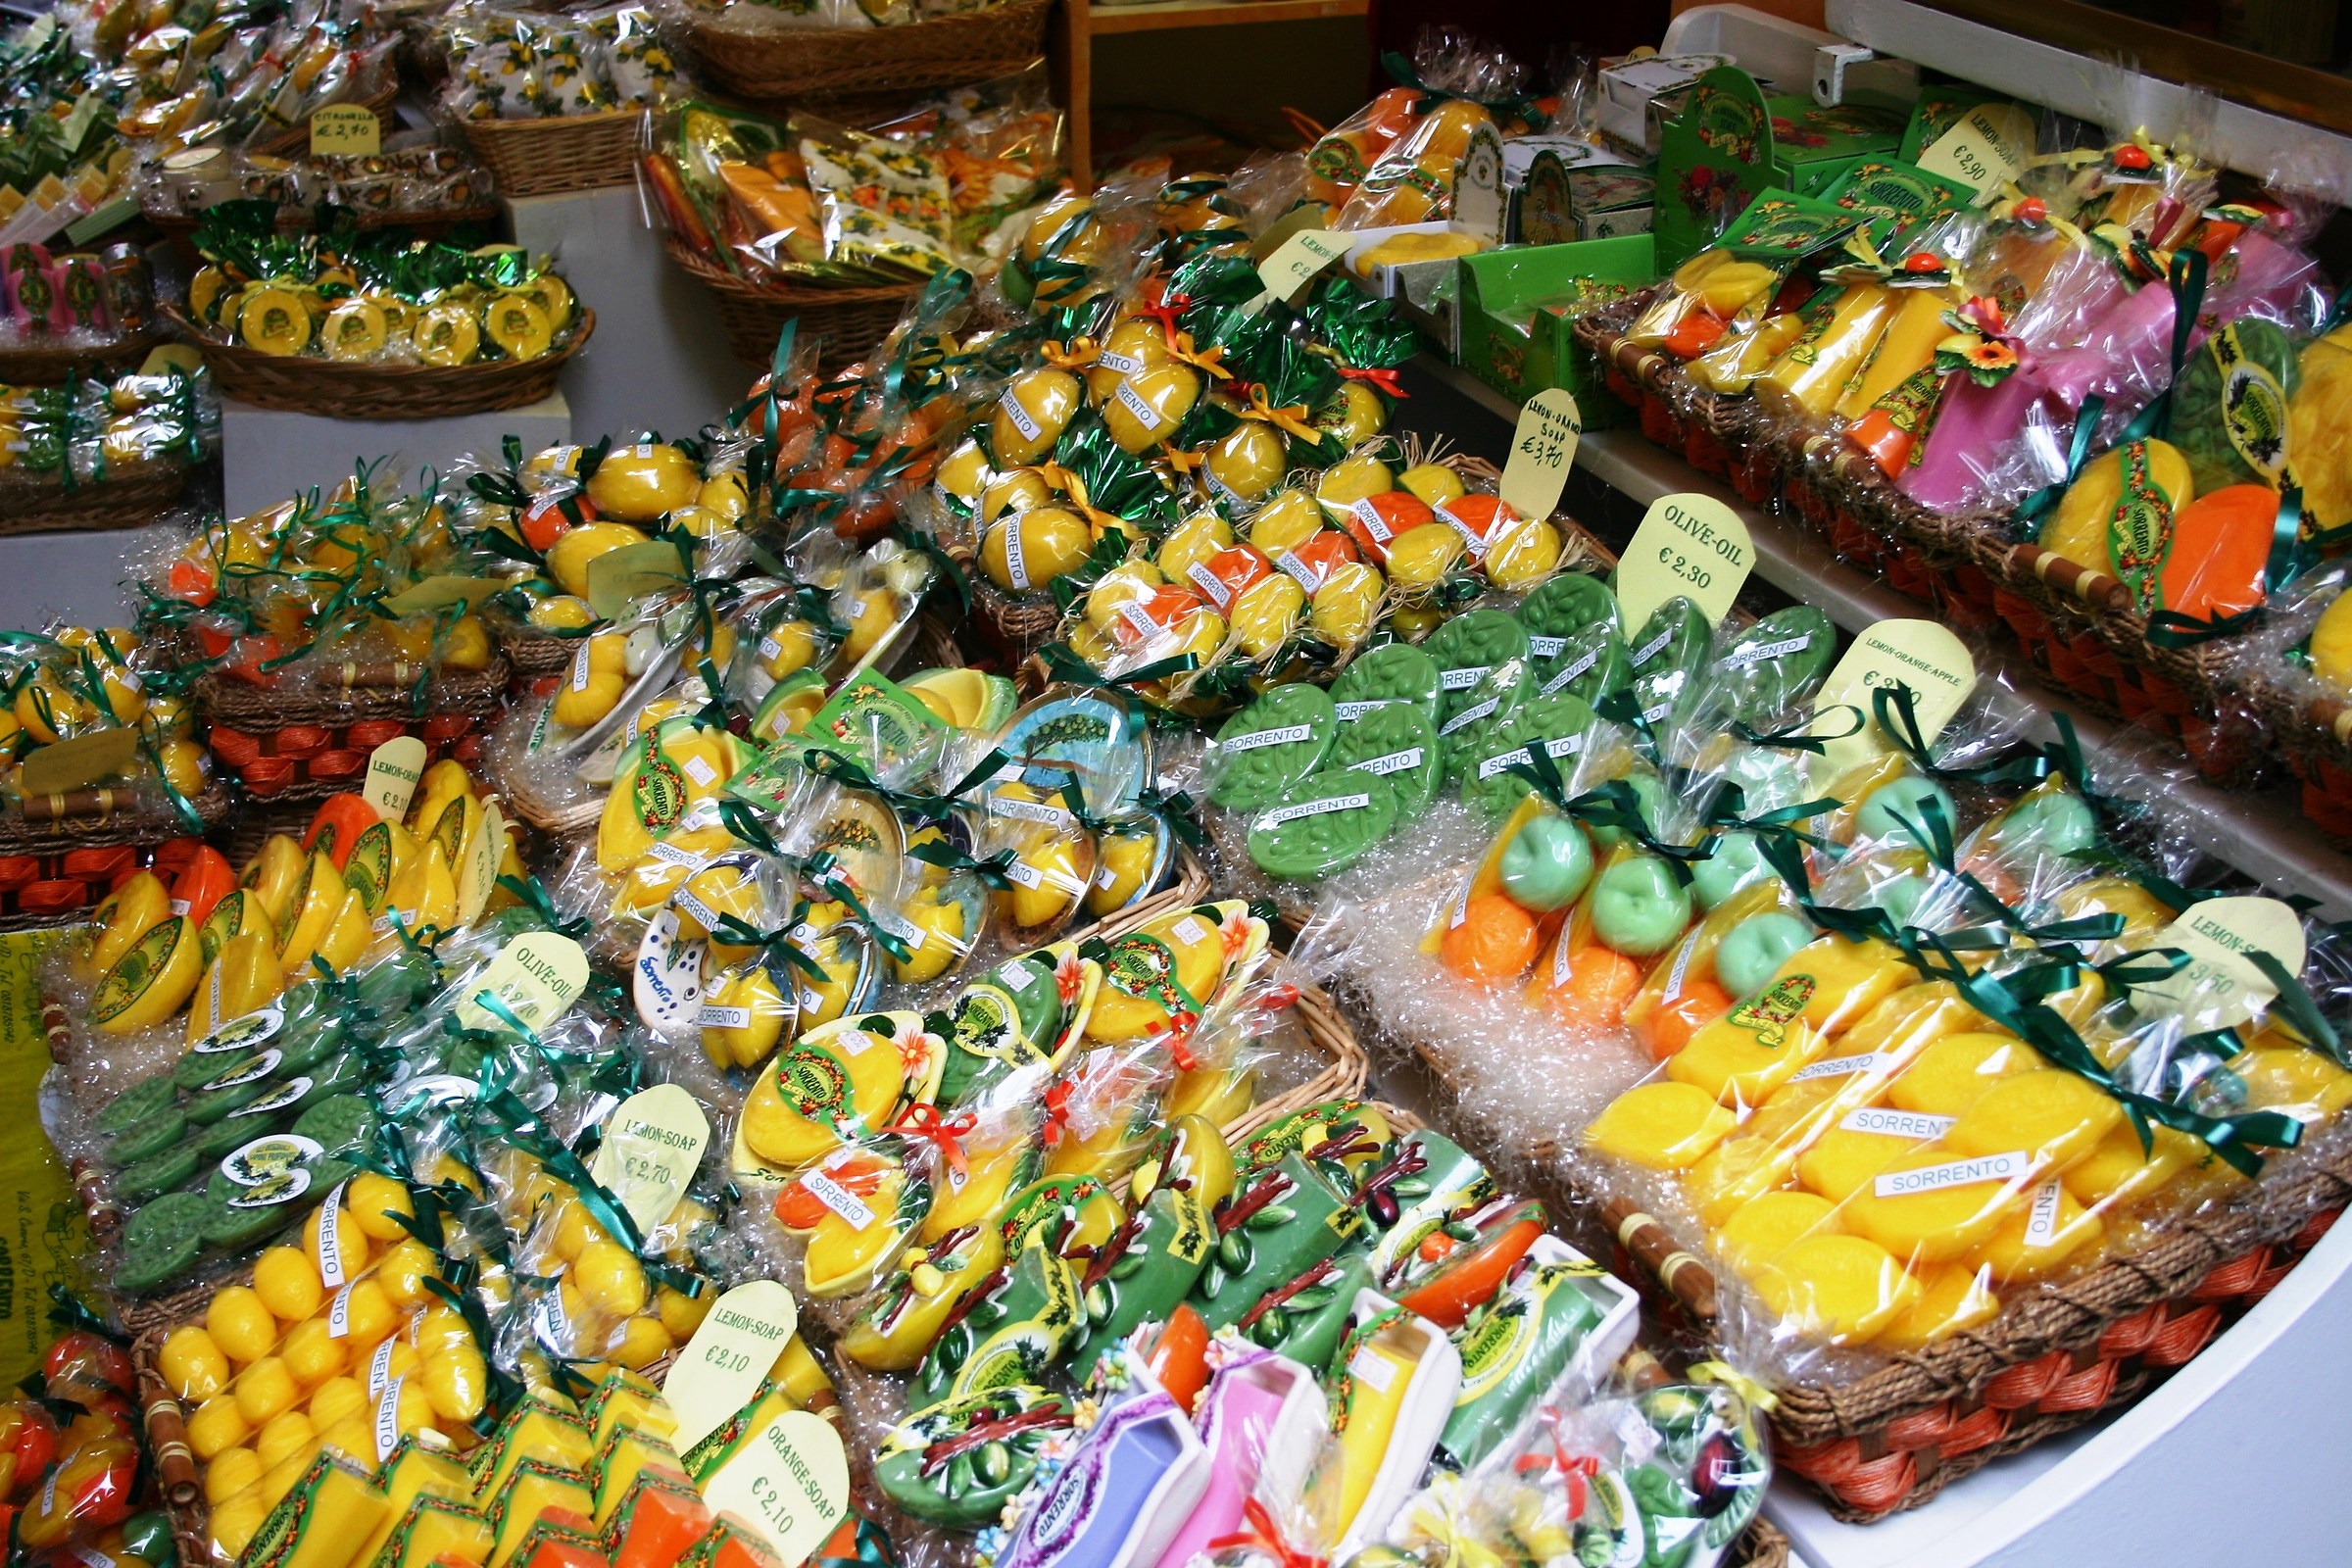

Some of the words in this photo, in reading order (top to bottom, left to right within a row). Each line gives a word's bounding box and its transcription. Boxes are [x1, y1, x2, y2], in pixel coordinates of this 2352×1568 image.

[1953, 145, 1967, 158] €
[1960, 153, 1986, 180] 2,90
[1540, 422, 1566, 443] SOAP
[1520, 436, 1535, 454] €
[1533, 440, 1563, 468] 3,70
[1664, 505, 1742, 566] OLIVE-OIL
[2132, 508, 2148, 555] SORRENTO
[1192, 566, 1226, 603] SORRENTO
[1280, 555, 1315, 588] SORRENTO
[1659, 547, 1674, 564] €
[1671, 557, 1711, 589] 2,30
[1863, 670, 1880, 686] €
[1865, 638, 1963, 686] LEMON-ORANGE-APPLE
[1226, 728, 1303, 752] SORRENTO
[1490, 740, 1571, 772] SORRTO
[653, 778, 668, 815] SORRENTO
[1273, 797, 1361, 823] SORRENTO
[653, 844, 697, 865] ORRENTO
[1124, 954, 1153, 979] SORRENTO
[797, 1066, 827, 1099] SORRENTO
[1793, 1055, 1873, 1080] SORRENTO
[637, 1161, 671, 1184] 2,70
[1892, 1157, 2010, 1191] SORRENTO
[322, 1192, 341, 1274] SORRENTO
[714, 1308, 784, 1342] LEMON-SOAP
[706, 1345, 718, 1362] €
[715, 1348, 750, 1373] 2,10
[1468, 1320, 1510, 1368] SORRENTO
[767, 1425, 837, 1521] ORANGE-SOAP
[752, 1476, 766, 1496] €
[761, 1487, 794, 1536] 2,10
[1040, 1475, 1079, 1538] SORRENTO
